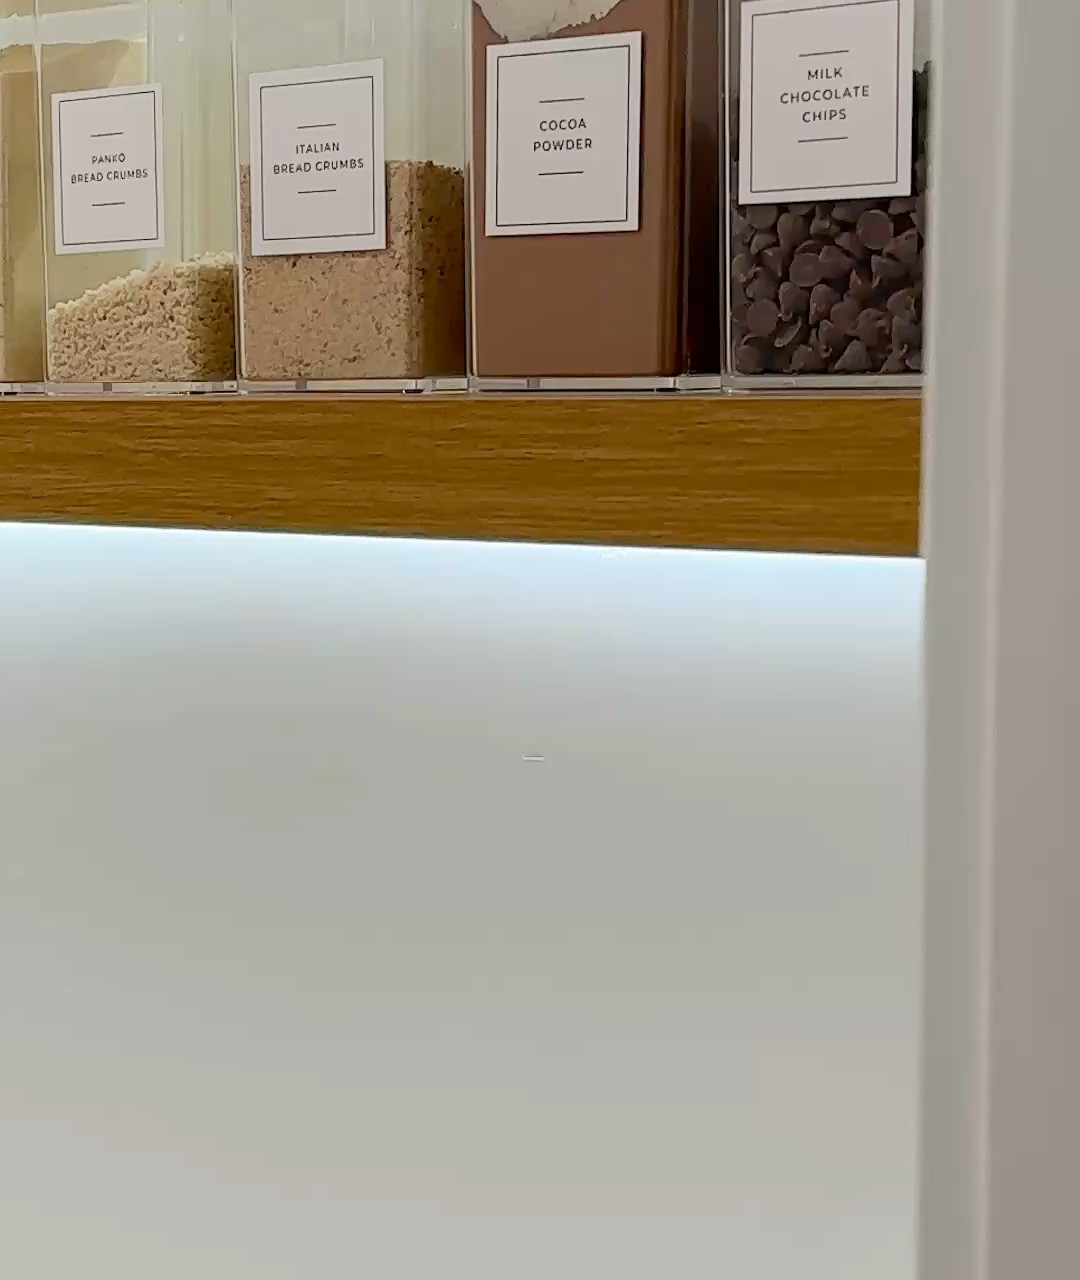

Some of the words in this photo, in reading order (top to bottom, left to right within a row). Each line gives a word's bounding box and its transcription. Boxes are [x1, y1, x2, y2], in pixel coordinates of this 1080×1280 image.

[807, 66, 843, 81] MILK
[779, 84, 870, 105] CHOCOLATE
[801, 107, 847, 124] CHIPS
[539, 117, 587, 133] COCOA
[295, 141, 340, 155] ITALIAN
[533, 137, 593, 153] POWDER
[91, 152, 126, 165] PANKO
[272, 161, 312, 175] BREAD
[314, 157, 365, 172] CRUMBS
[70, 171, 104, 185] BREAD
[106, 168, 149, 181] CRUMBS
